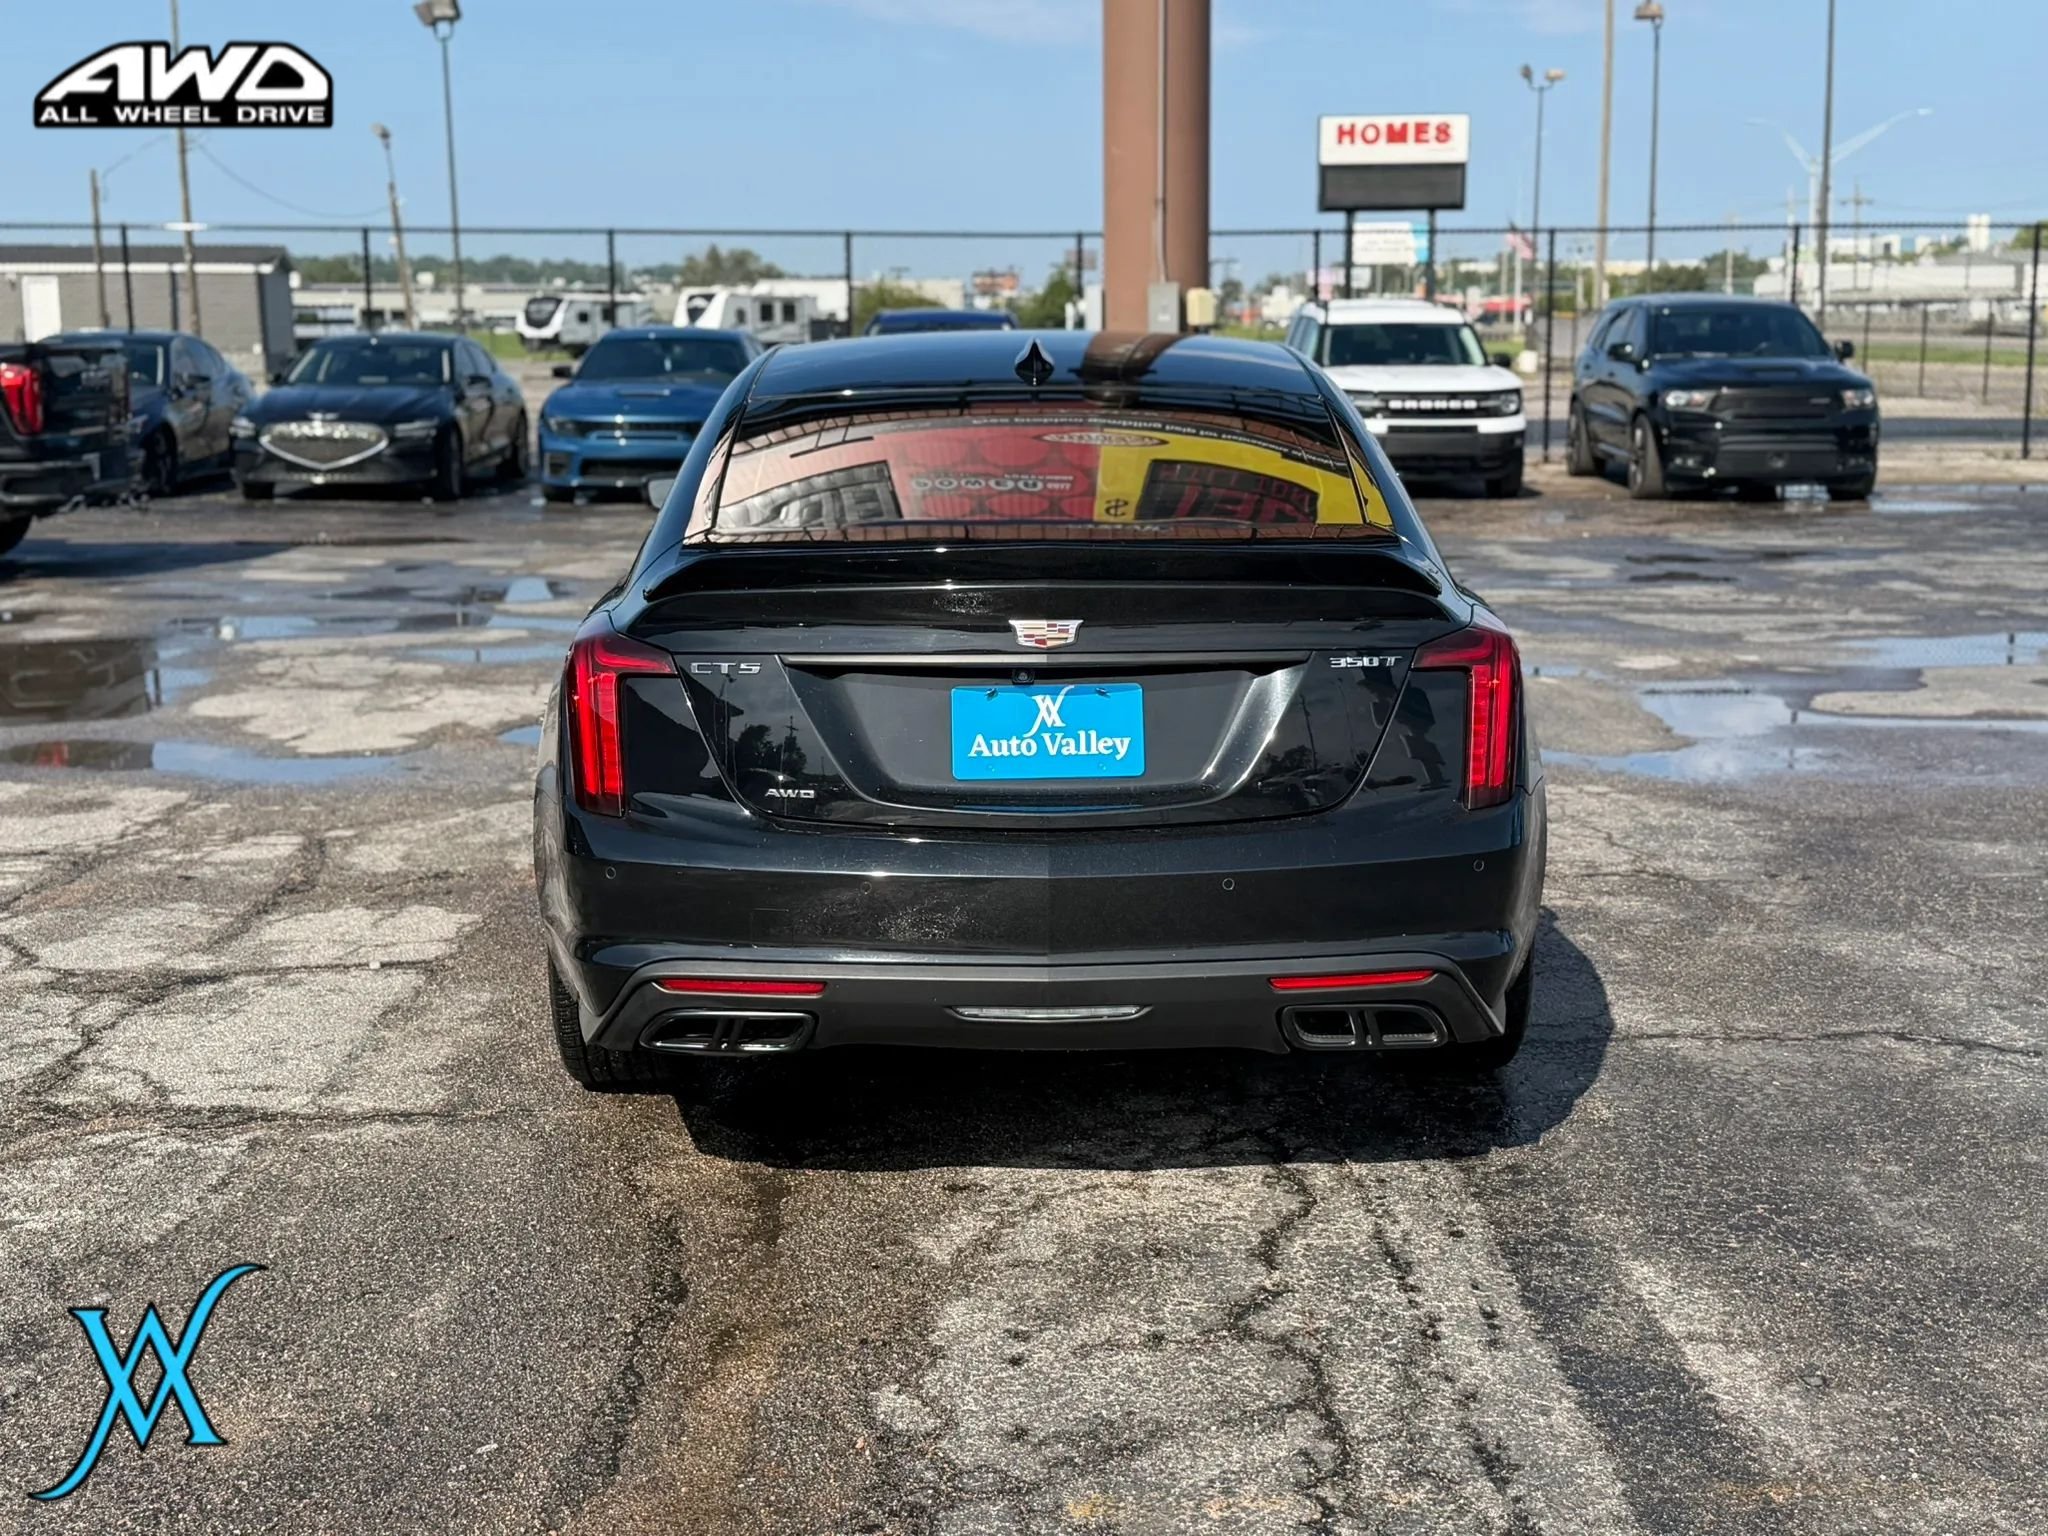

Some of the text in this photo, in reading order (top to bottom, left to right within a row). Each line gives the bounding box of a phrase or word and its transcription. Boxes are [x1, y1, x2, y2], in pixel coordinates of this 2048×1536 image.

[1336, 122, 1453, 145] HOMES
[1329, 655, 1403, 668] 350T
[968, 730, 1132, 760] Auto Valley
[764, 788, 815, 799] AWD
